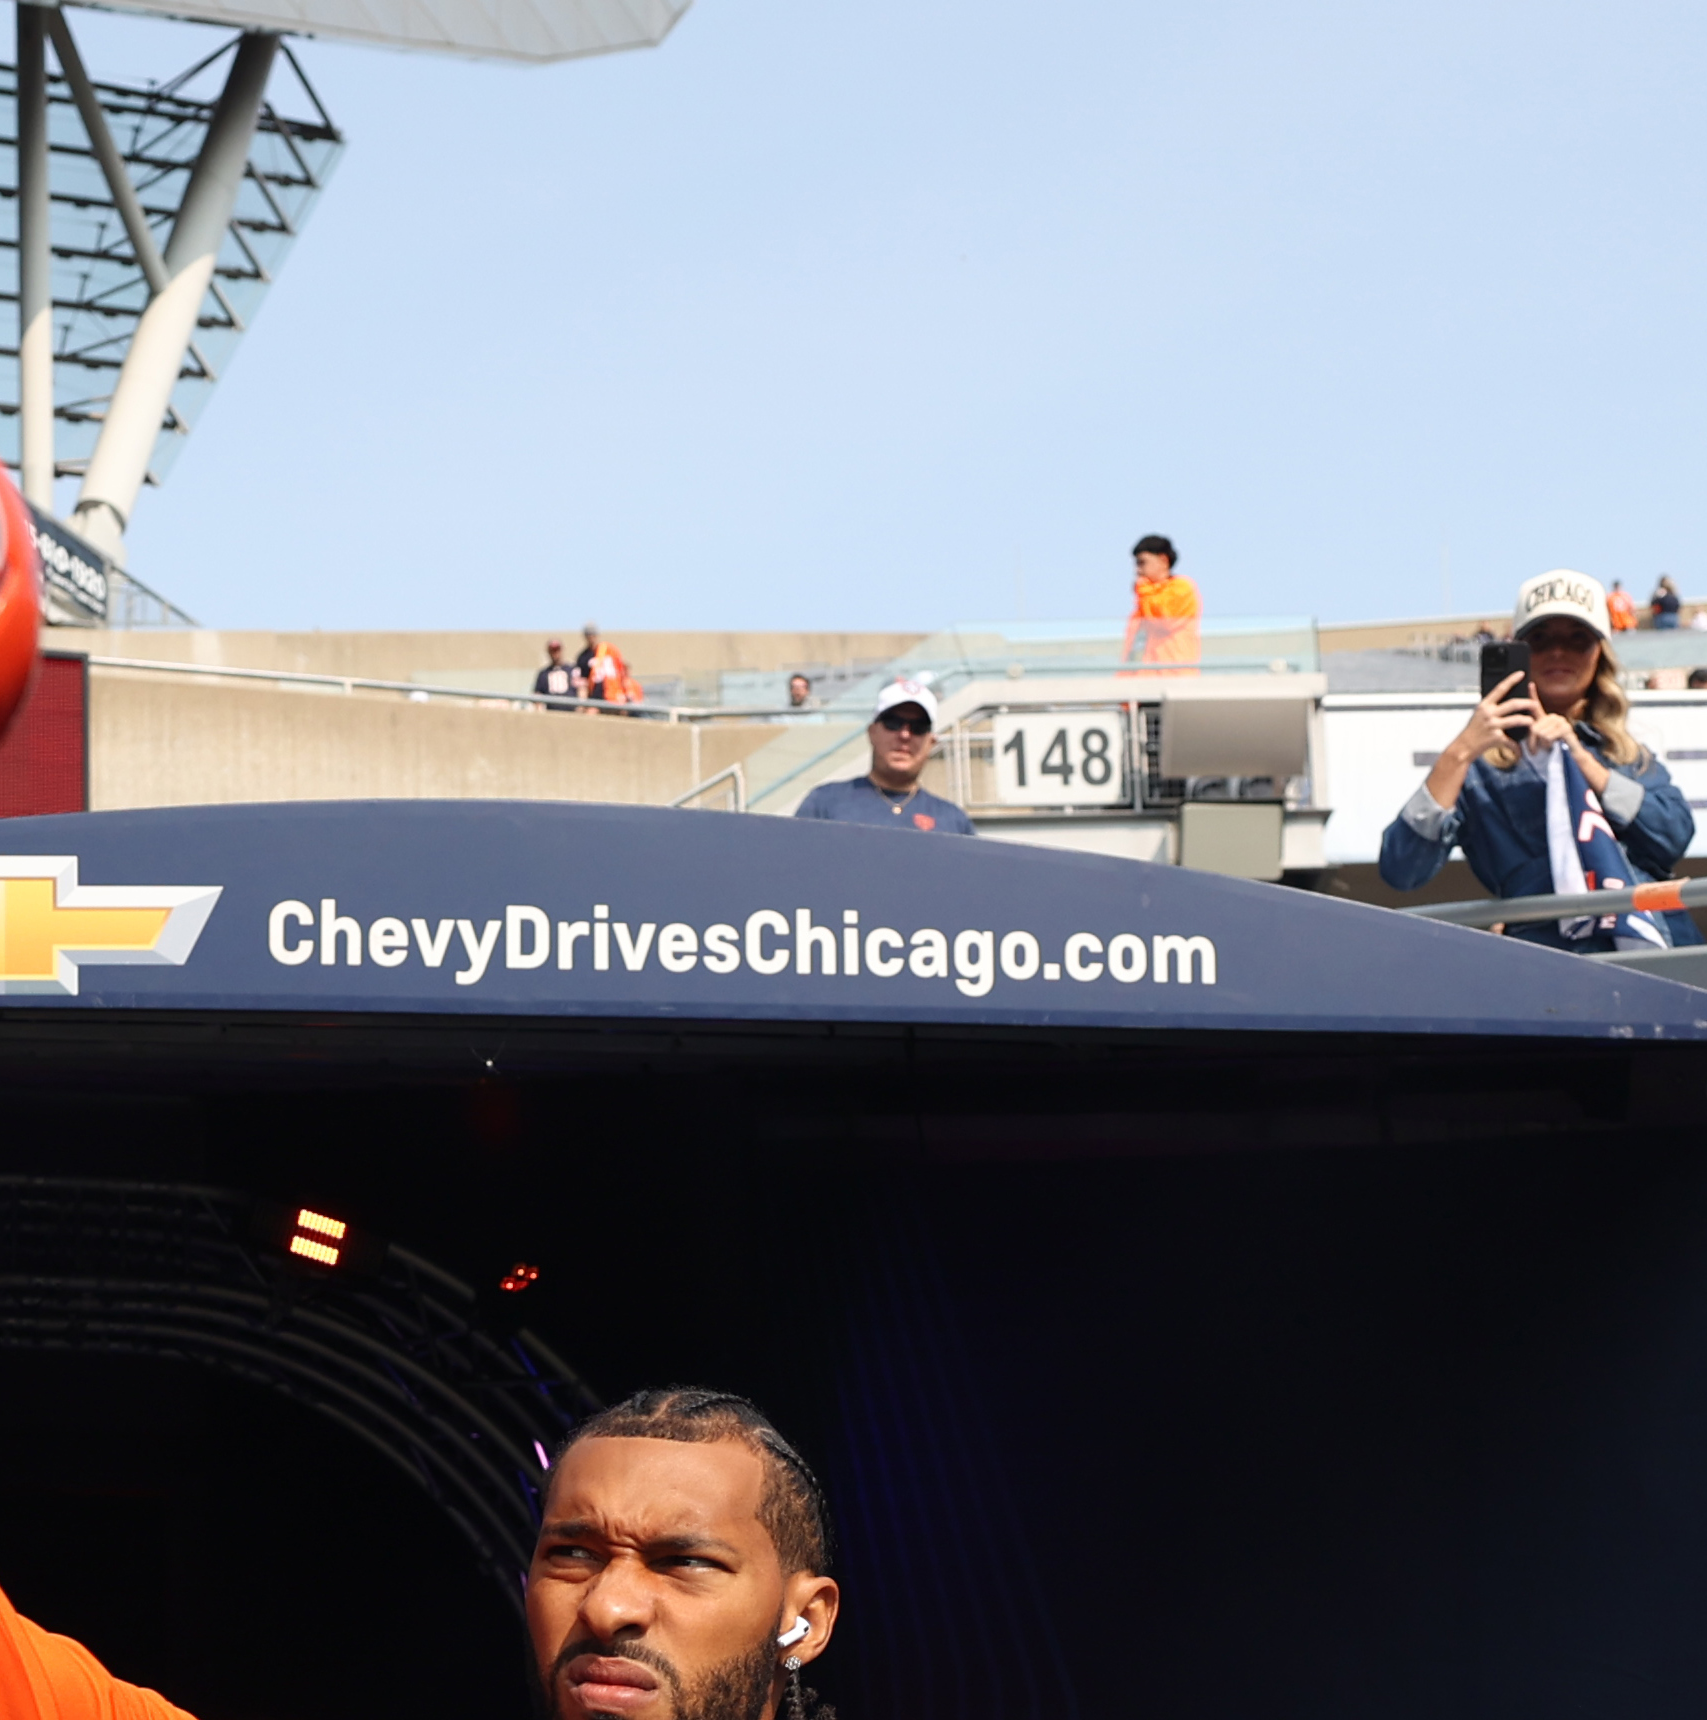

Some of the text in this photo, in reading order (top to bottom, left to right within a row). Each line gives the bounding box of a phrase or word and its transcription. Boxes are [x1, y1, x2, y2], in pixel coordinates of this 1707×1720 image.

[1524, 578, 1594, 613] CHICAGO
[1003, 729, 1112, 787] 148
[267, 898, 1219, 998] ChevyDrivesChicago.com
